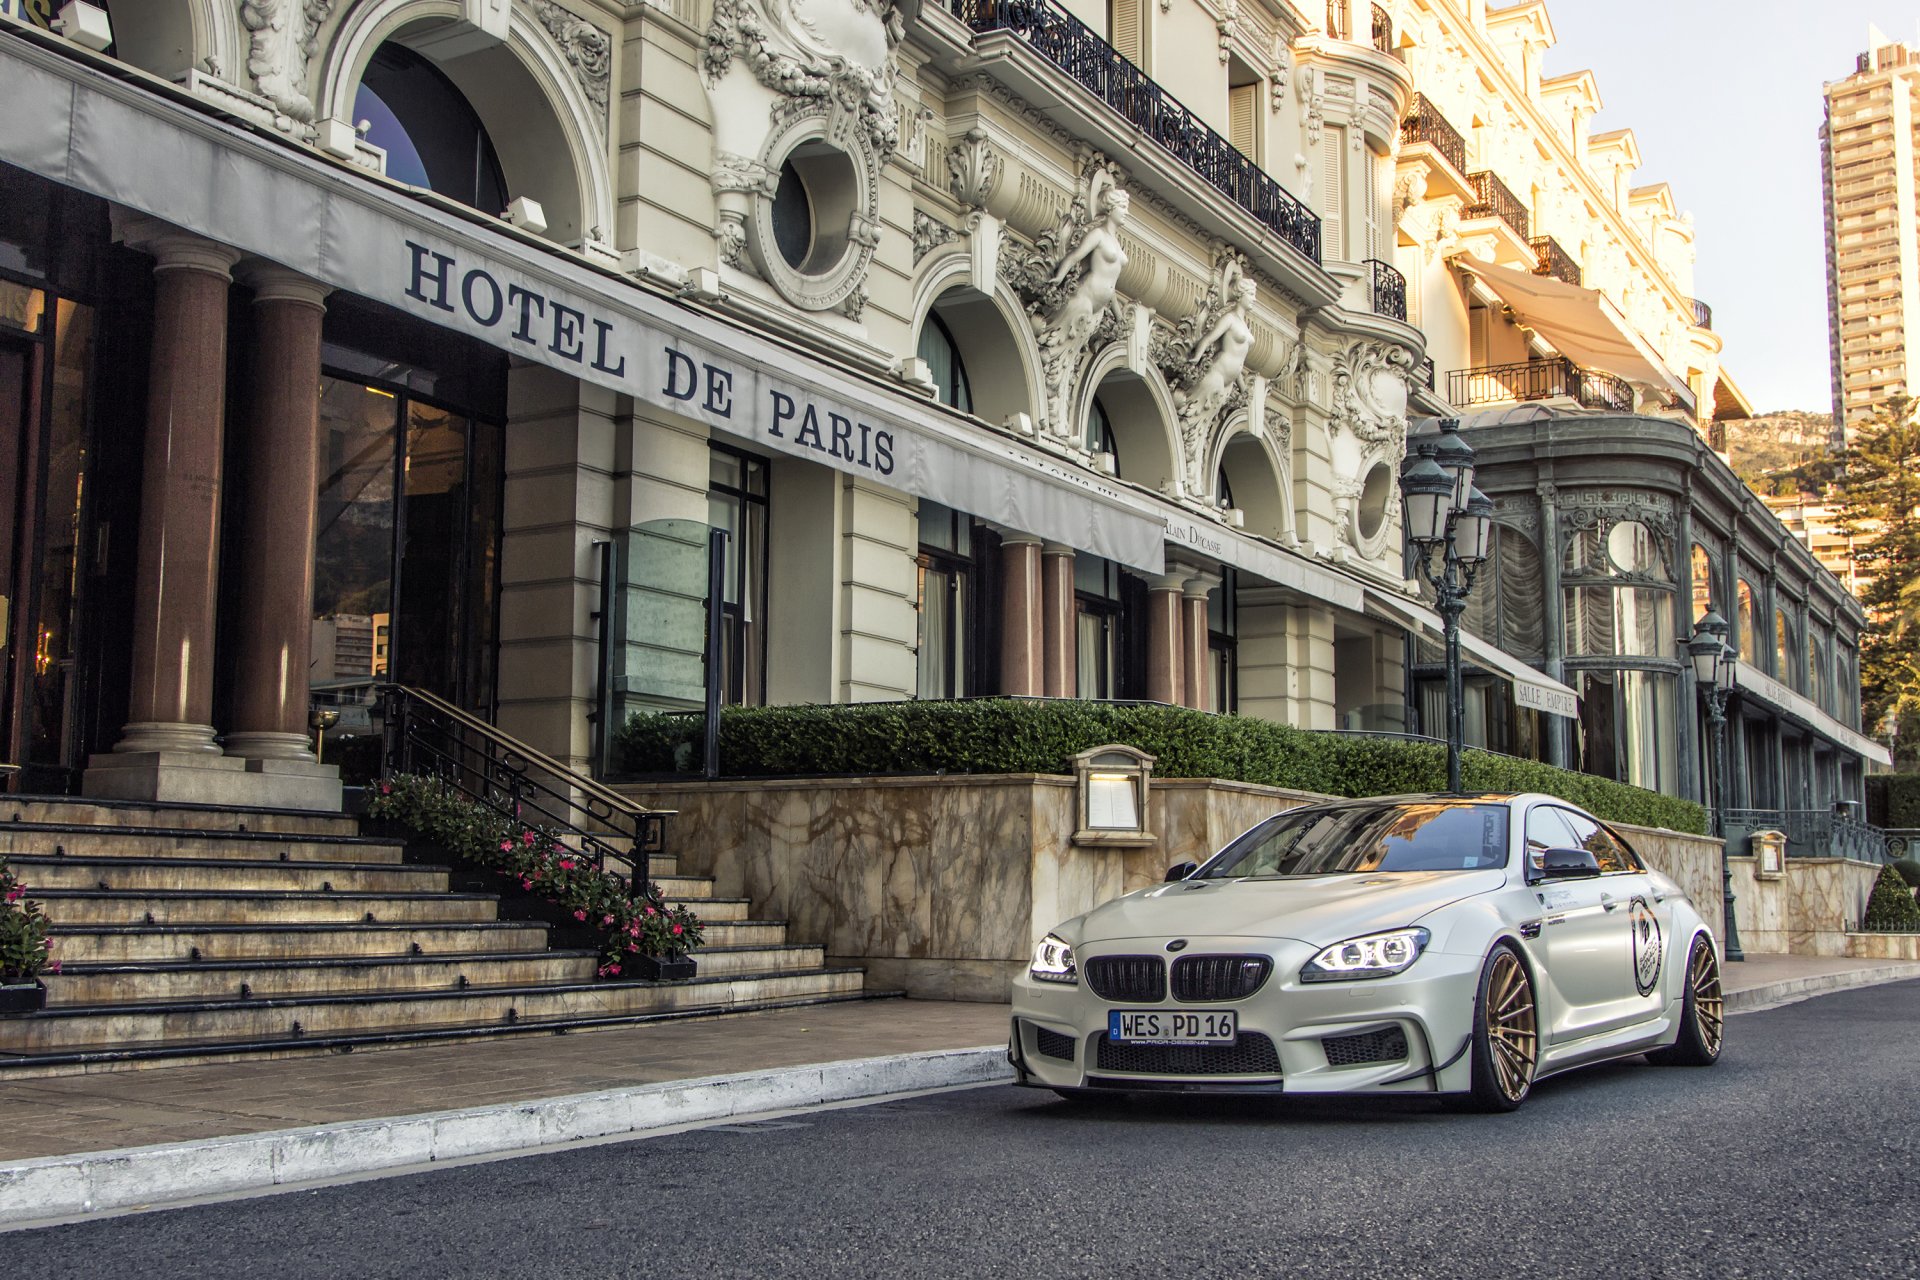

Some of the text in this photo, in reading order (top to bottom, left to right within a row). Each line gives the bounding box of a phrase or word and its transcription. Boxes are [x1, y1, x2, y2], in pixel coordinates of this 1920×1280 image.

[405, 239, 896, 476] HOTEL DE PARIS
[1520, 684, 1574, 713] SALLE EMPIRE
[1122, 1014, 1160, 1037] WES
[1173, 1014, 1200, 1037] PD
[1205, 1015, 1232, 1037] 16
